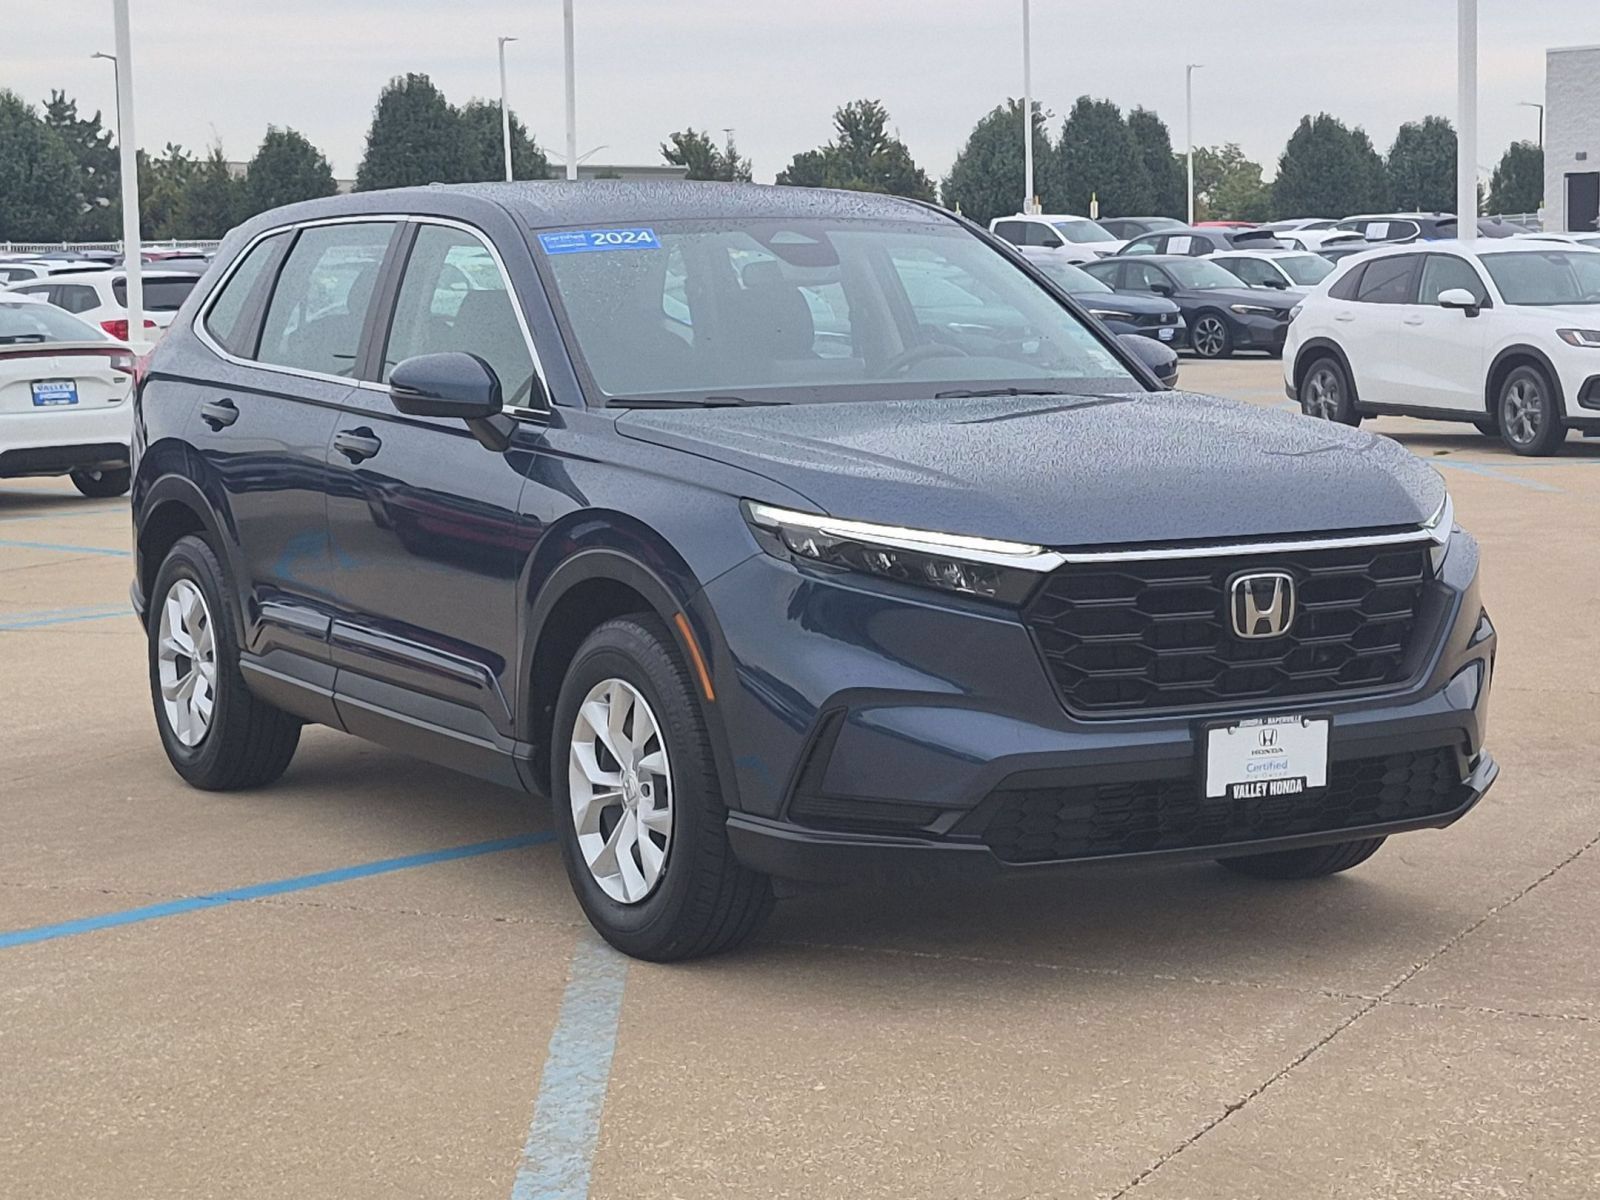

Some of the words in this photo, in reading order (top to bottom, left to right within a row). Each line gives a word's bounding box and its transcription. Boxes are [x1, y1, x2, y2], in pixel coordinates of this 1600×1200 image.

[591, 231, 653, 246] 2024
[1251, 747, 1283, 756] HONDA
[1246, 760, 1288, 773] Certified
[1233, 782, 1268, 799] VALLEY
[1269, 779, 1303, 796] HONDA
